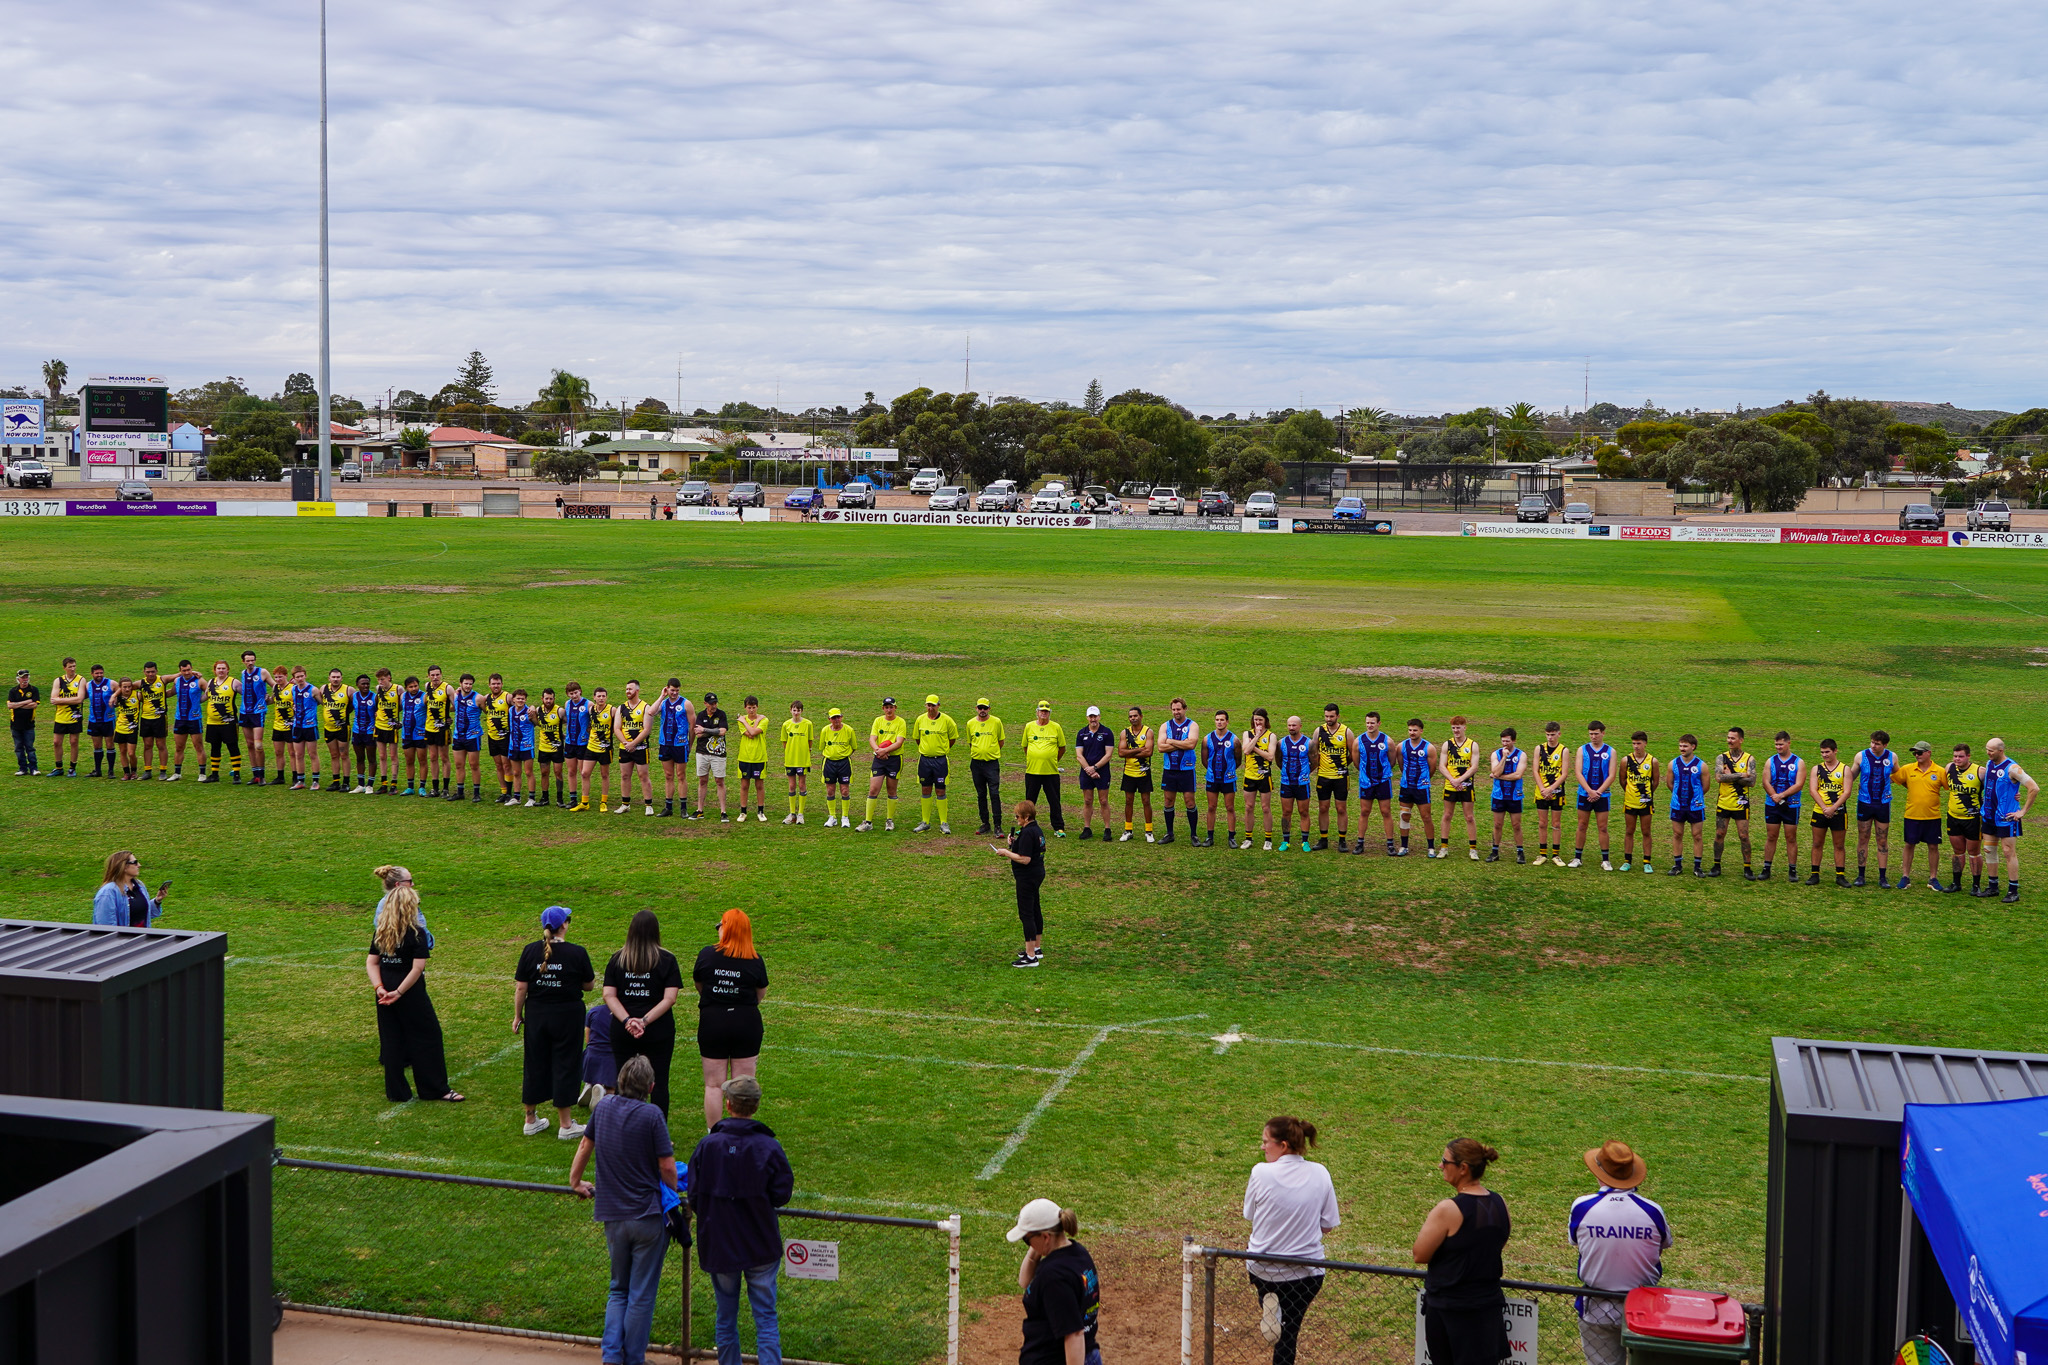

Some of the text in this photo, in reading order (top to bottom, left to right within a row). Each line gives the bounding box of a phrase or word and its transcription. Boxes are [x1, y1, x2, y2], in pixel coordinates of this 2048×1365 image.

[5, 502, 60, 516] 13 33 77
[565, 505, 609, 515] CBCH
[844, 511, 1070, 527] Silvern Guardian Security Services
[1622, 527, 1670, 536] McLEOD'S
[1789, 532, 1907, 543] Whyalla Travel & Cruise
[1972, 533, 2043, 543] PERROTT &
[714, 969, 741, 978] KICKING
[712, 986, 739, 994] CAUSE
[1586, 1226, 1653, 1240] TRAINER
[1502, 1303, 1533, 1318] ATER
